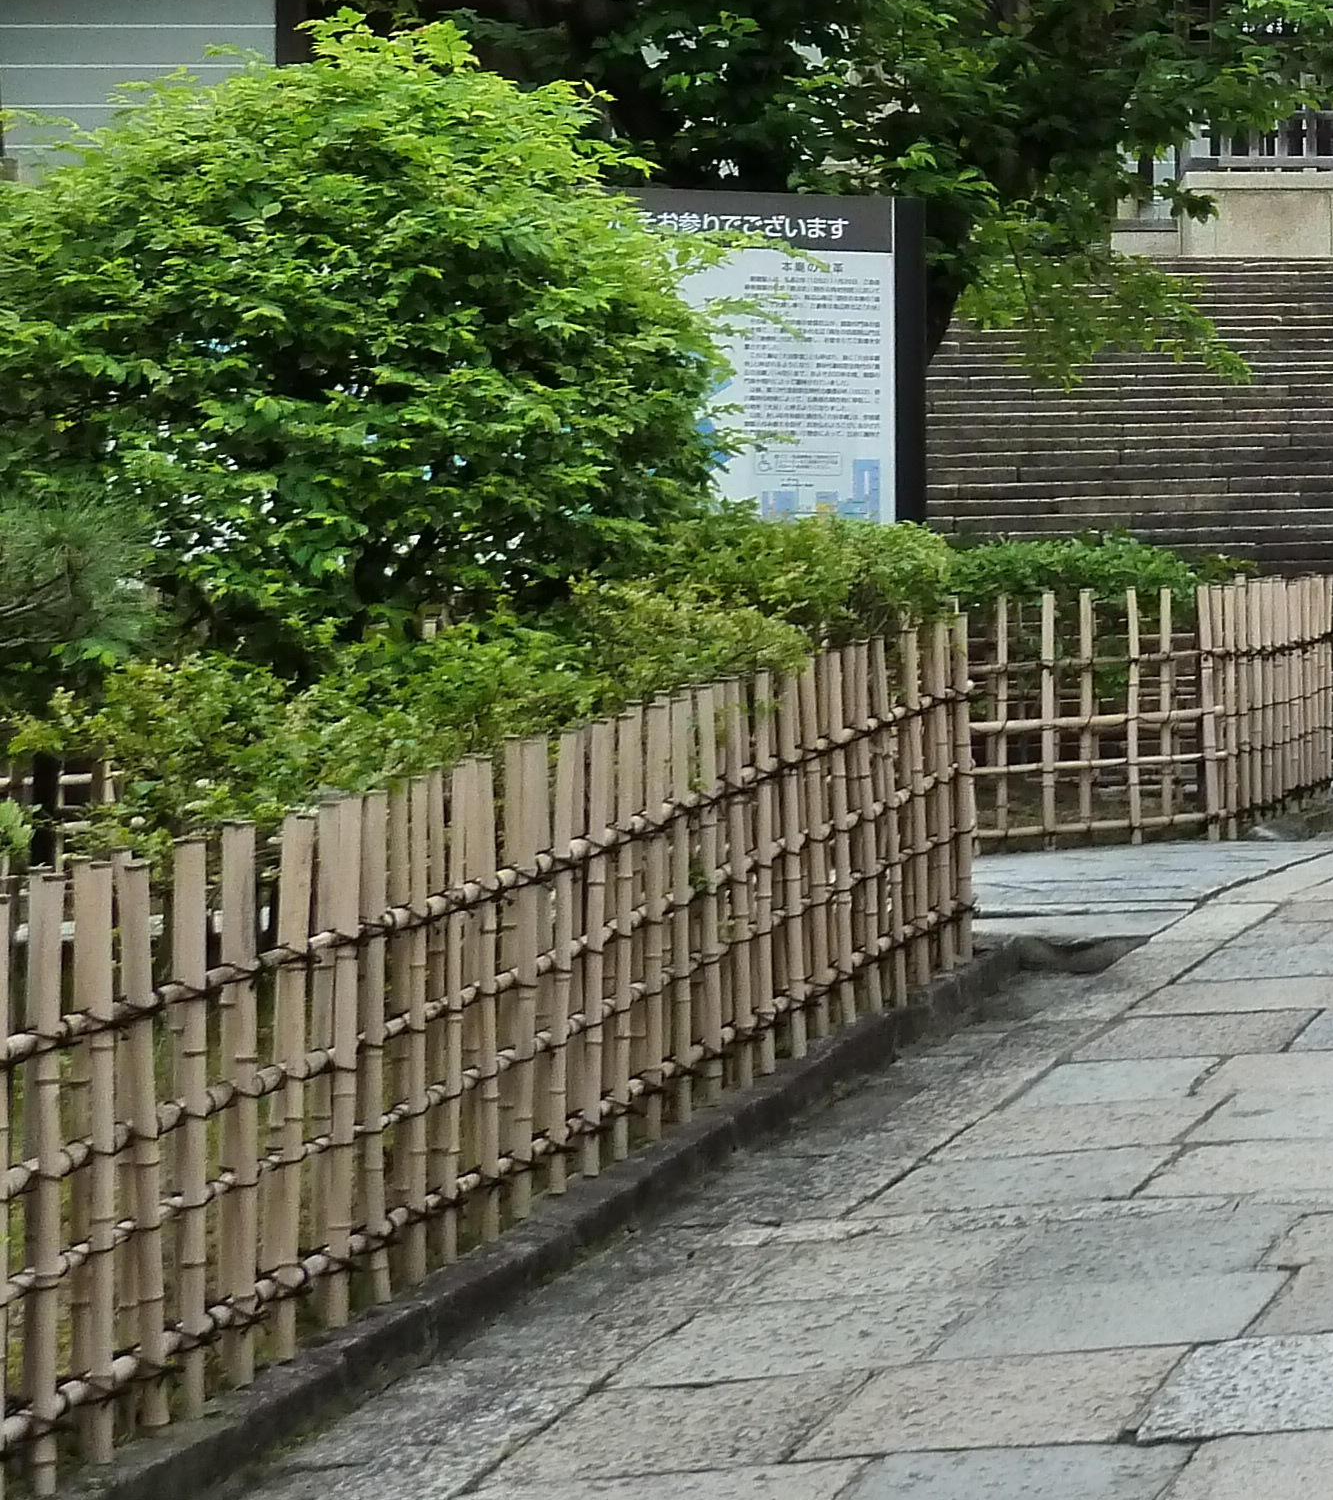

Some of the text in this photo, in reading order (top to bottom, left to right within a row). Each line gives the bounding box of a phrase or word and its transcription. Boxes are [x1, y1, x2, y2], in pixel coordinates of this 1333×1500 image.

[607, 211, 849, 240] そお参りでございます
